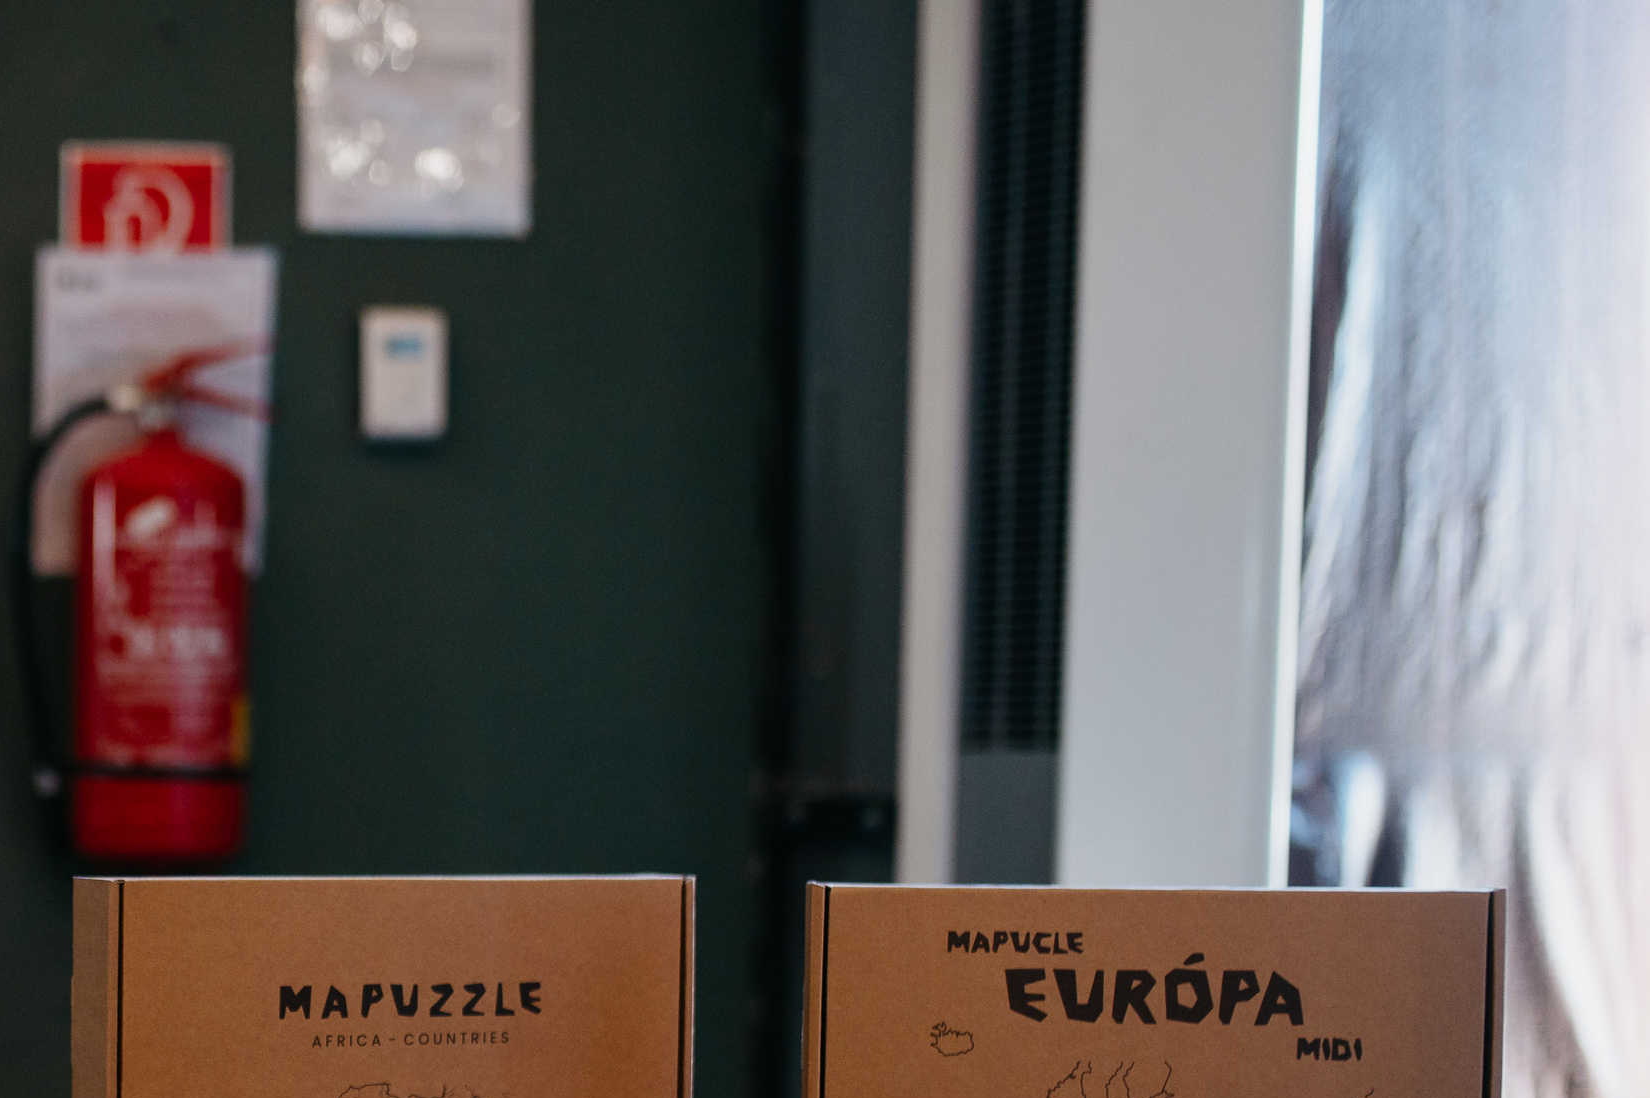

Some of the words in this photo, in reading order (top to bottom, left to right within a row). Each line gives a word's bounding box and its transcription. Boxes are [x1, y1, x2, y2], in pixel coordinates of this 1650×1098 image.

[947, 931, 1083, 954] MAPUCLE
[279, 982, 542, 1020] MAPUZZLE
[1005, 953, 1304, 1026] EURÓPA
[312, 1034, 381, 1048] AFRICA
[403, 1032, 510, 1046] COUNTRIES
[1296, 1037, 1362, 1062] MIDI
